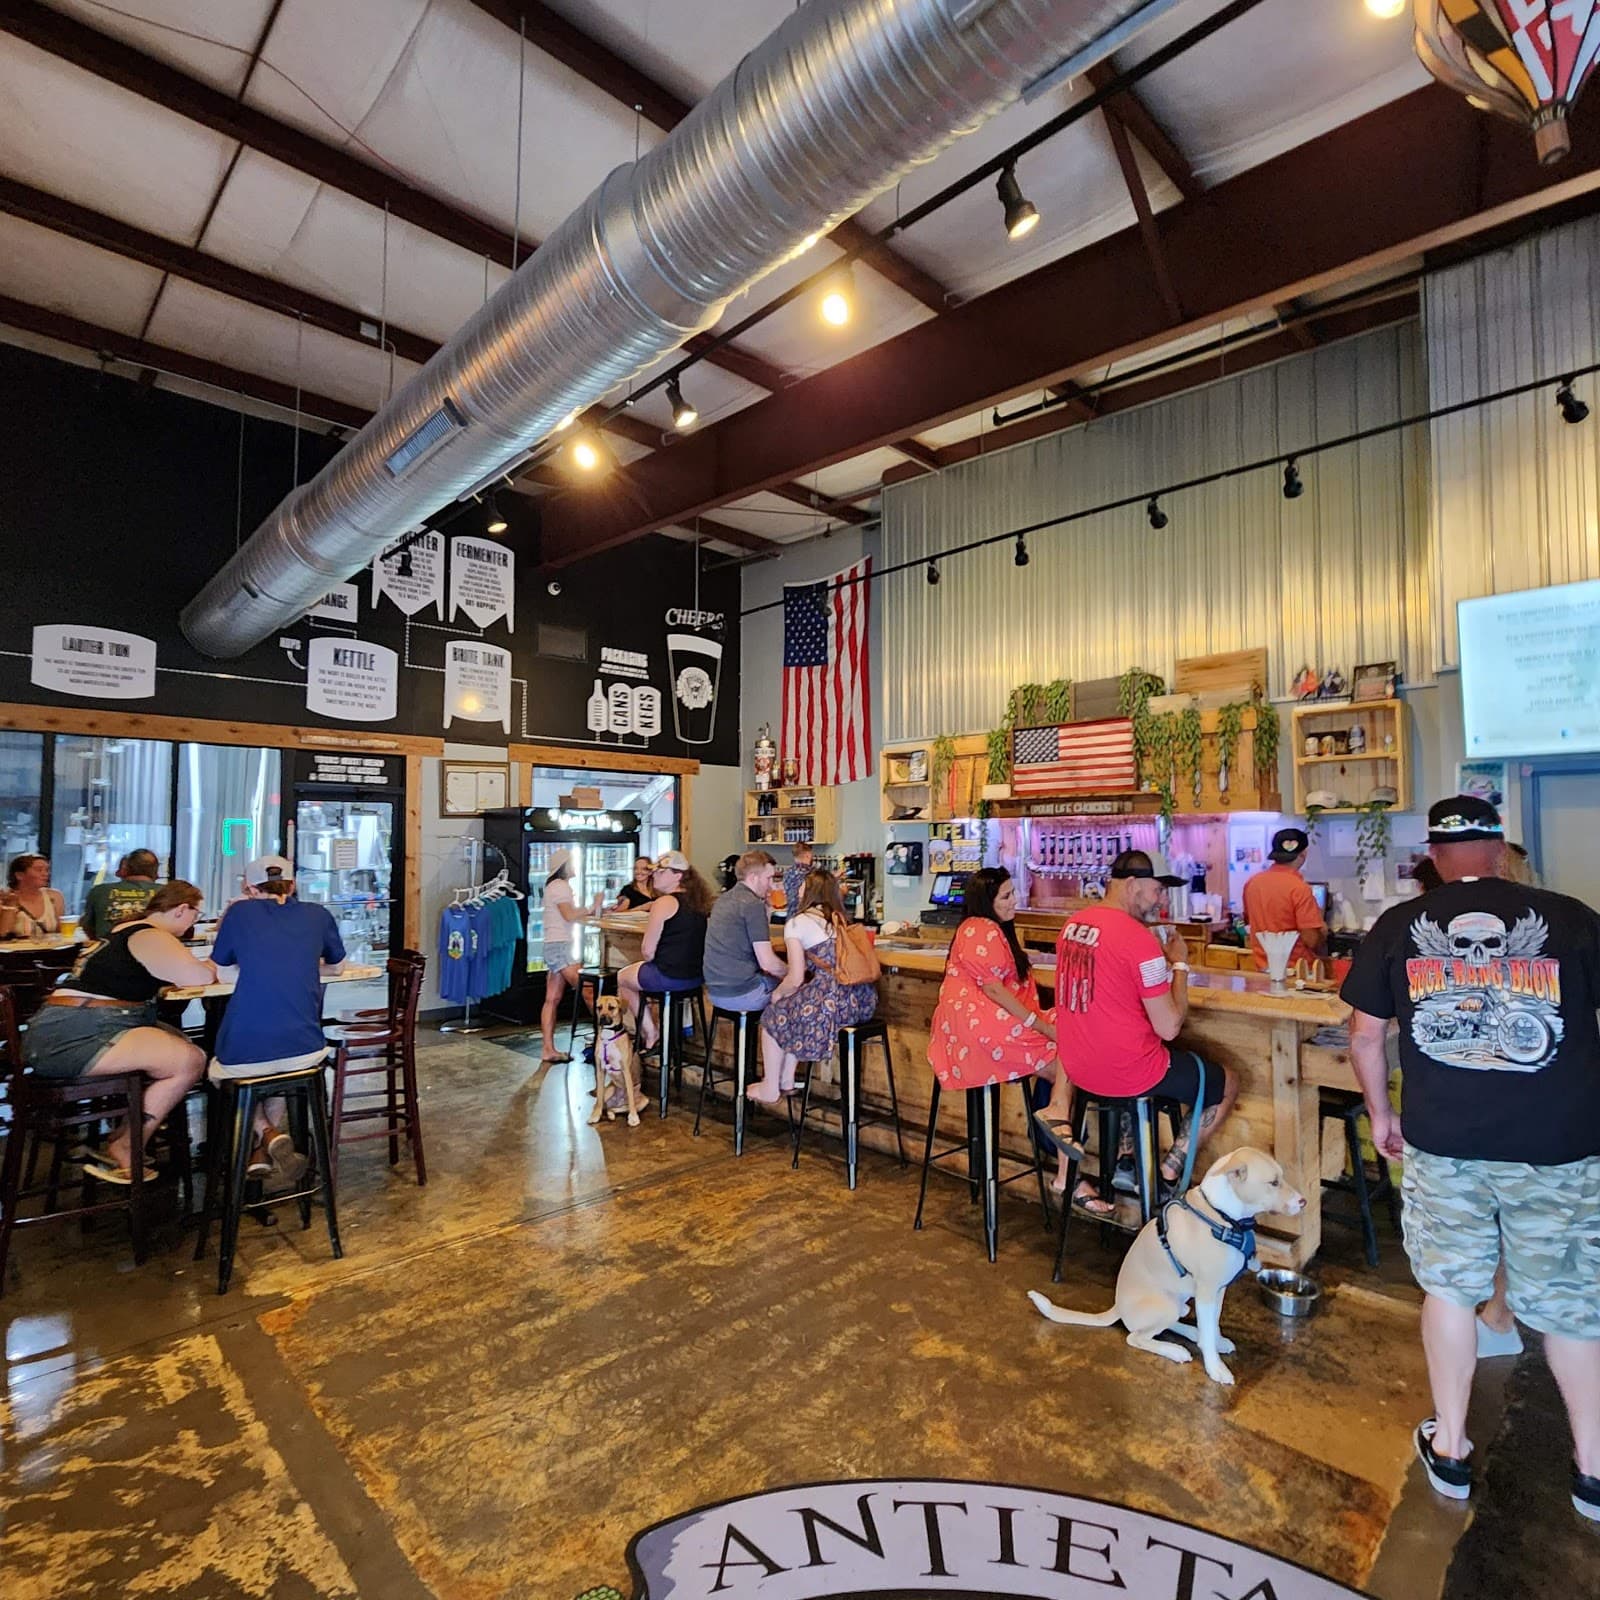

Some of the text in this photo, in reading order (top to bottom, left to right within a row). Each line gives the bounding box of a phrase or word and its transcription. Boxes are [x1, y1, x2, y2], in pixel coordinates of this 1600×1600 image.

[456, 542, 508, 568] FERMENTER
[665, 608, 724, 630] CHEERS
[62, 636, 104, 655] LAUTER
[333, 647, 376, 671] KETTLE
[613, 690, 628, 727] CANS
[639, 693, 654, 729] KEGS
[929, 820, 981, 840] LIFE IS
[1406, 957, 1561, 1007] SUCK BANG BLOW
